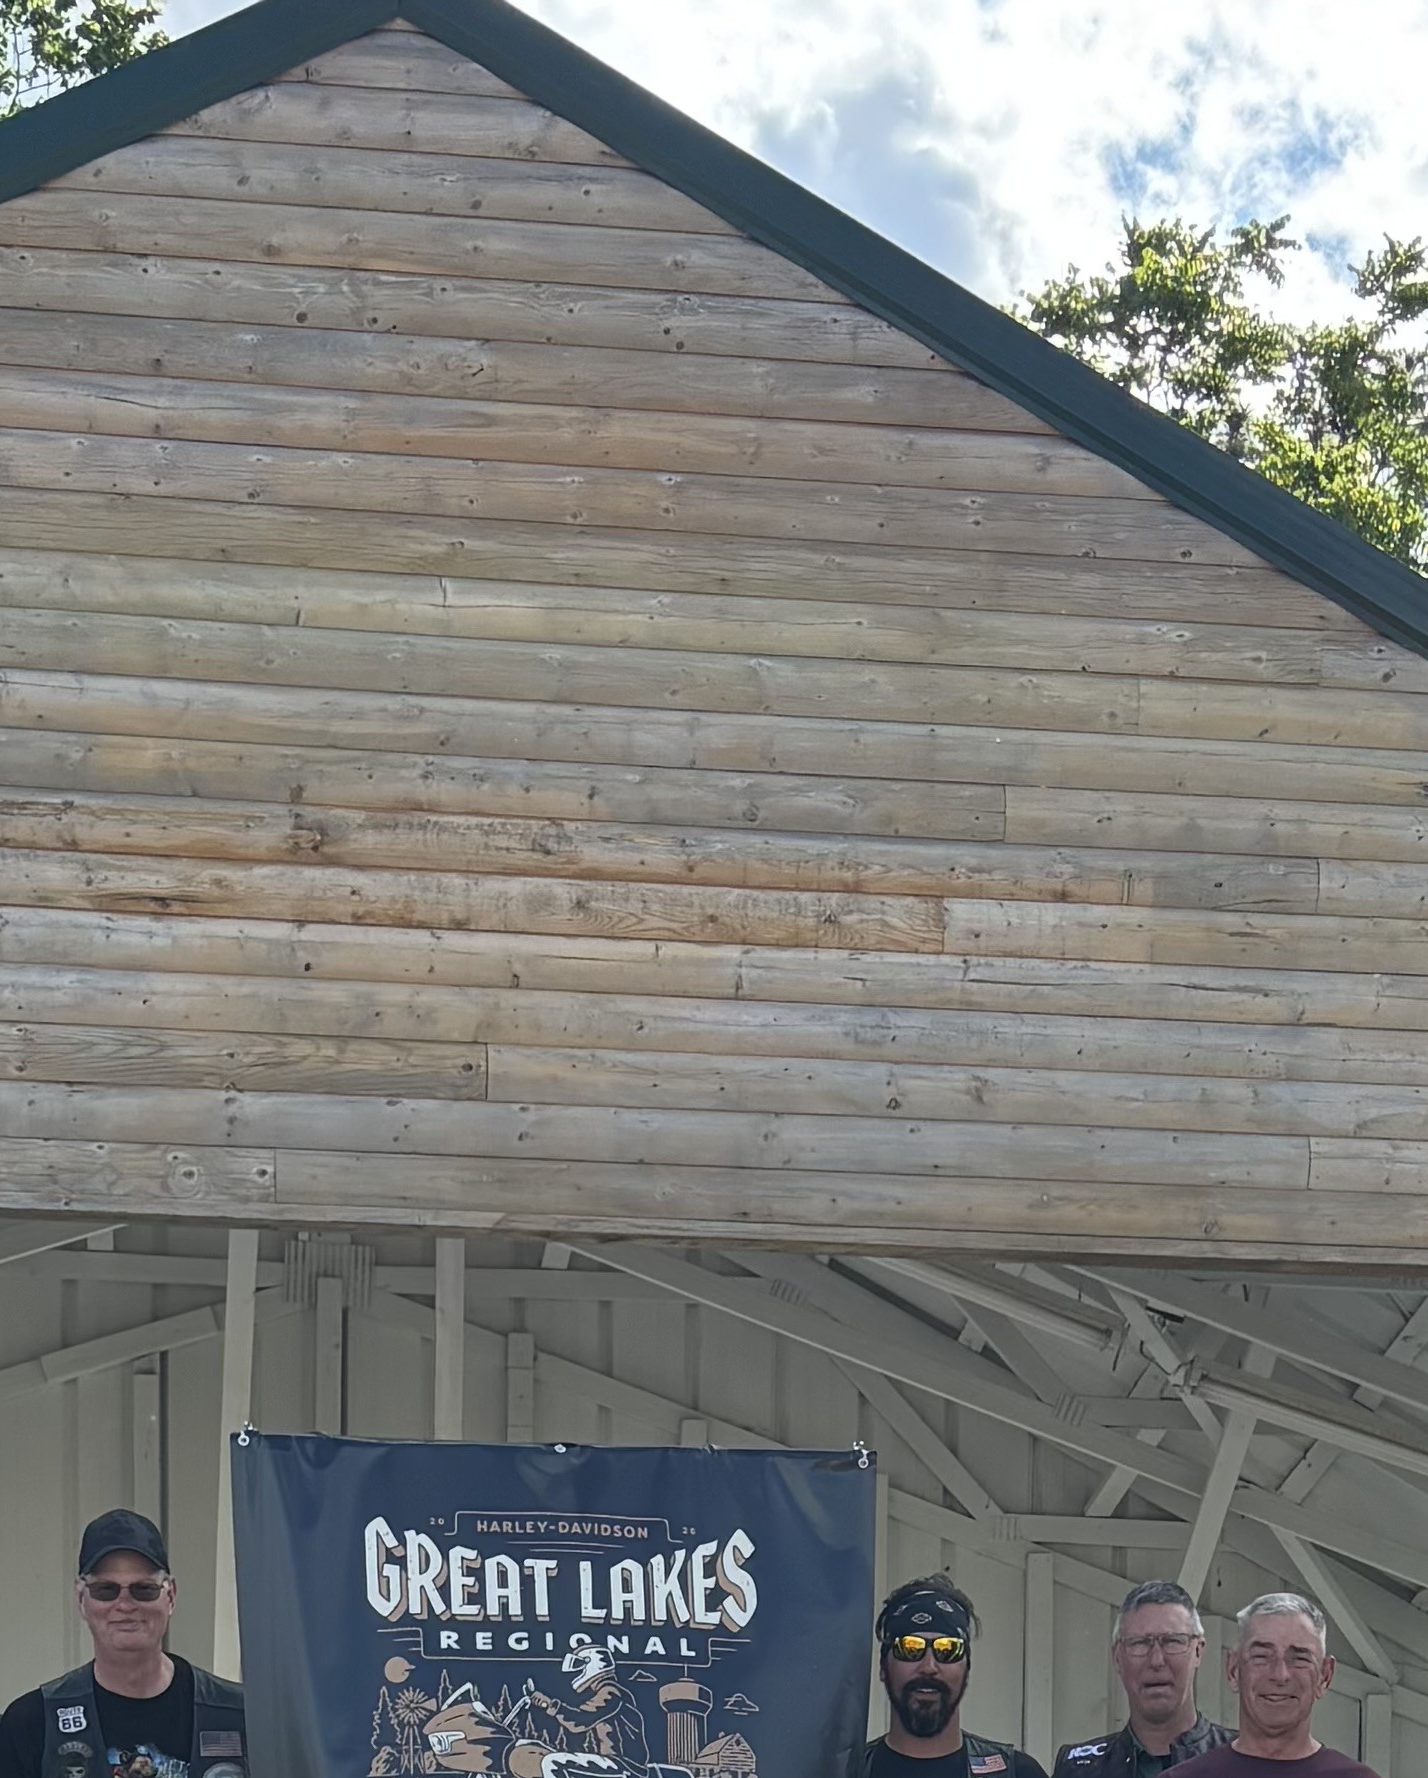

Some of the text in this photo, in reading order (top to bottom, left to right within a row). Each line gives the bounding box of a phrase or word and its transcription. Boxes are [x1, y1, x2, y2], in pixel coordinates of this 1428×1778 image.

[429, 1516, 445, 1526] 20
[476, 1519, 649, 1540] HARLEY-DAVIDSON
[364, 1516, 758, 1631] GREAT LAKES
[61, 1716, 83, 1730] 66
